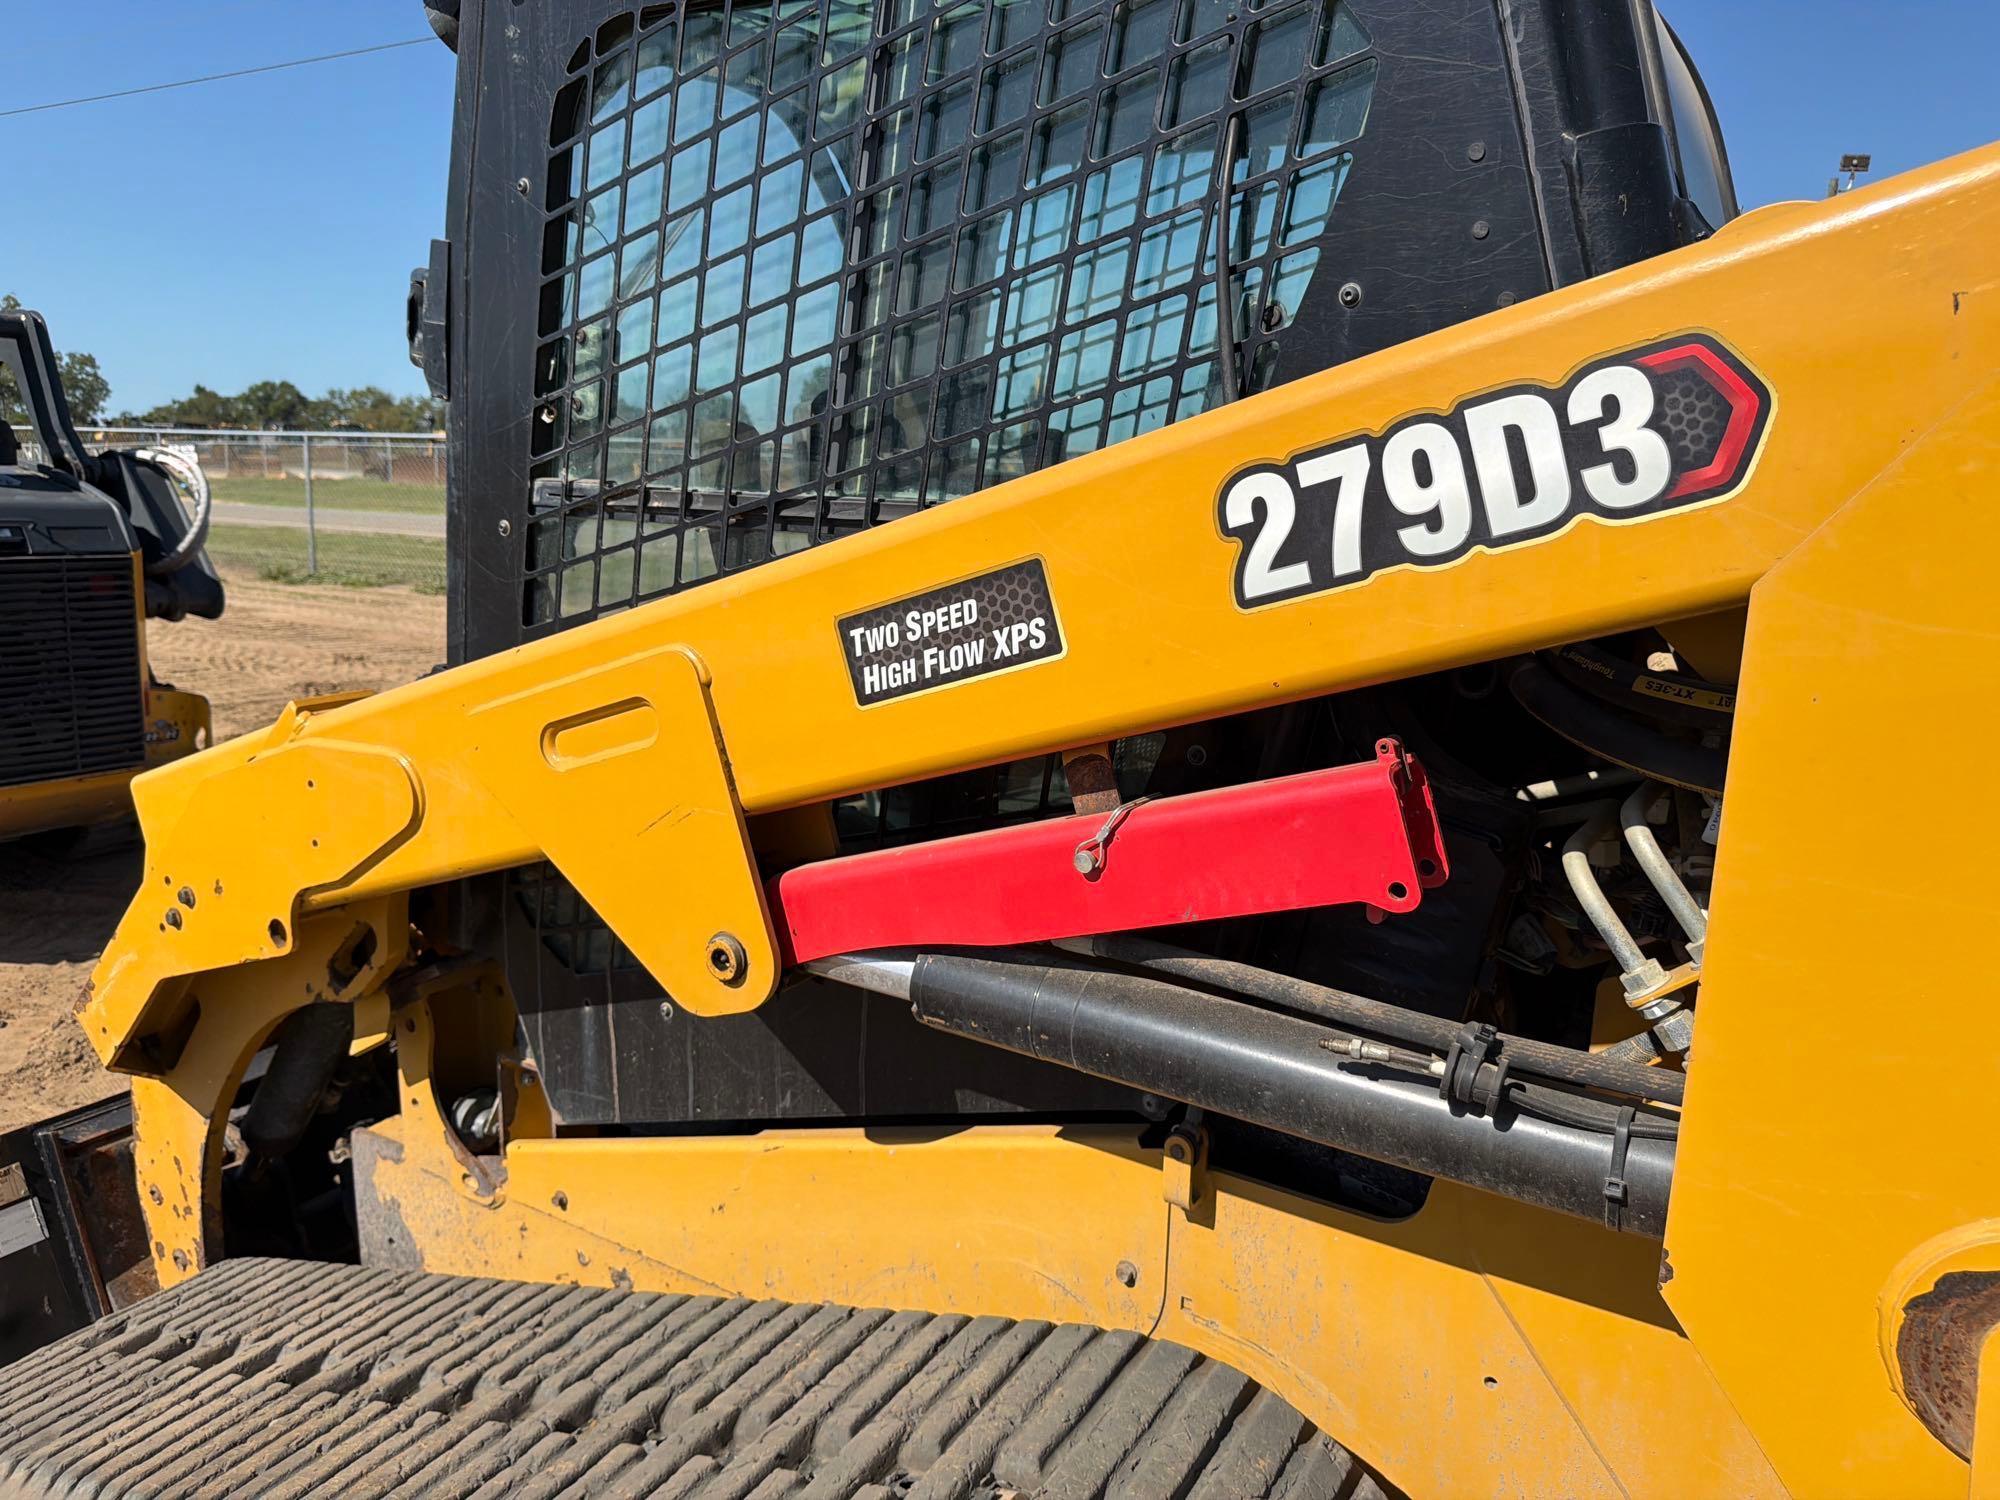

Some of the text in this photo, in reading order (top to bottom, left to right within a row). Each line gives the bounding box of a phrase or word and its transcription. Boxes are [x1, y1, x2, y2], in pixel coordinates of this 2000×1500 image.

[1224, 364, 1671, 600] 279D3
[849, 598, 978, 658] TWO SPEED
[863, 616, 1046, 695] HIGH FLOW XPS
[1645, 680, 1697, 700] XT-3ES
